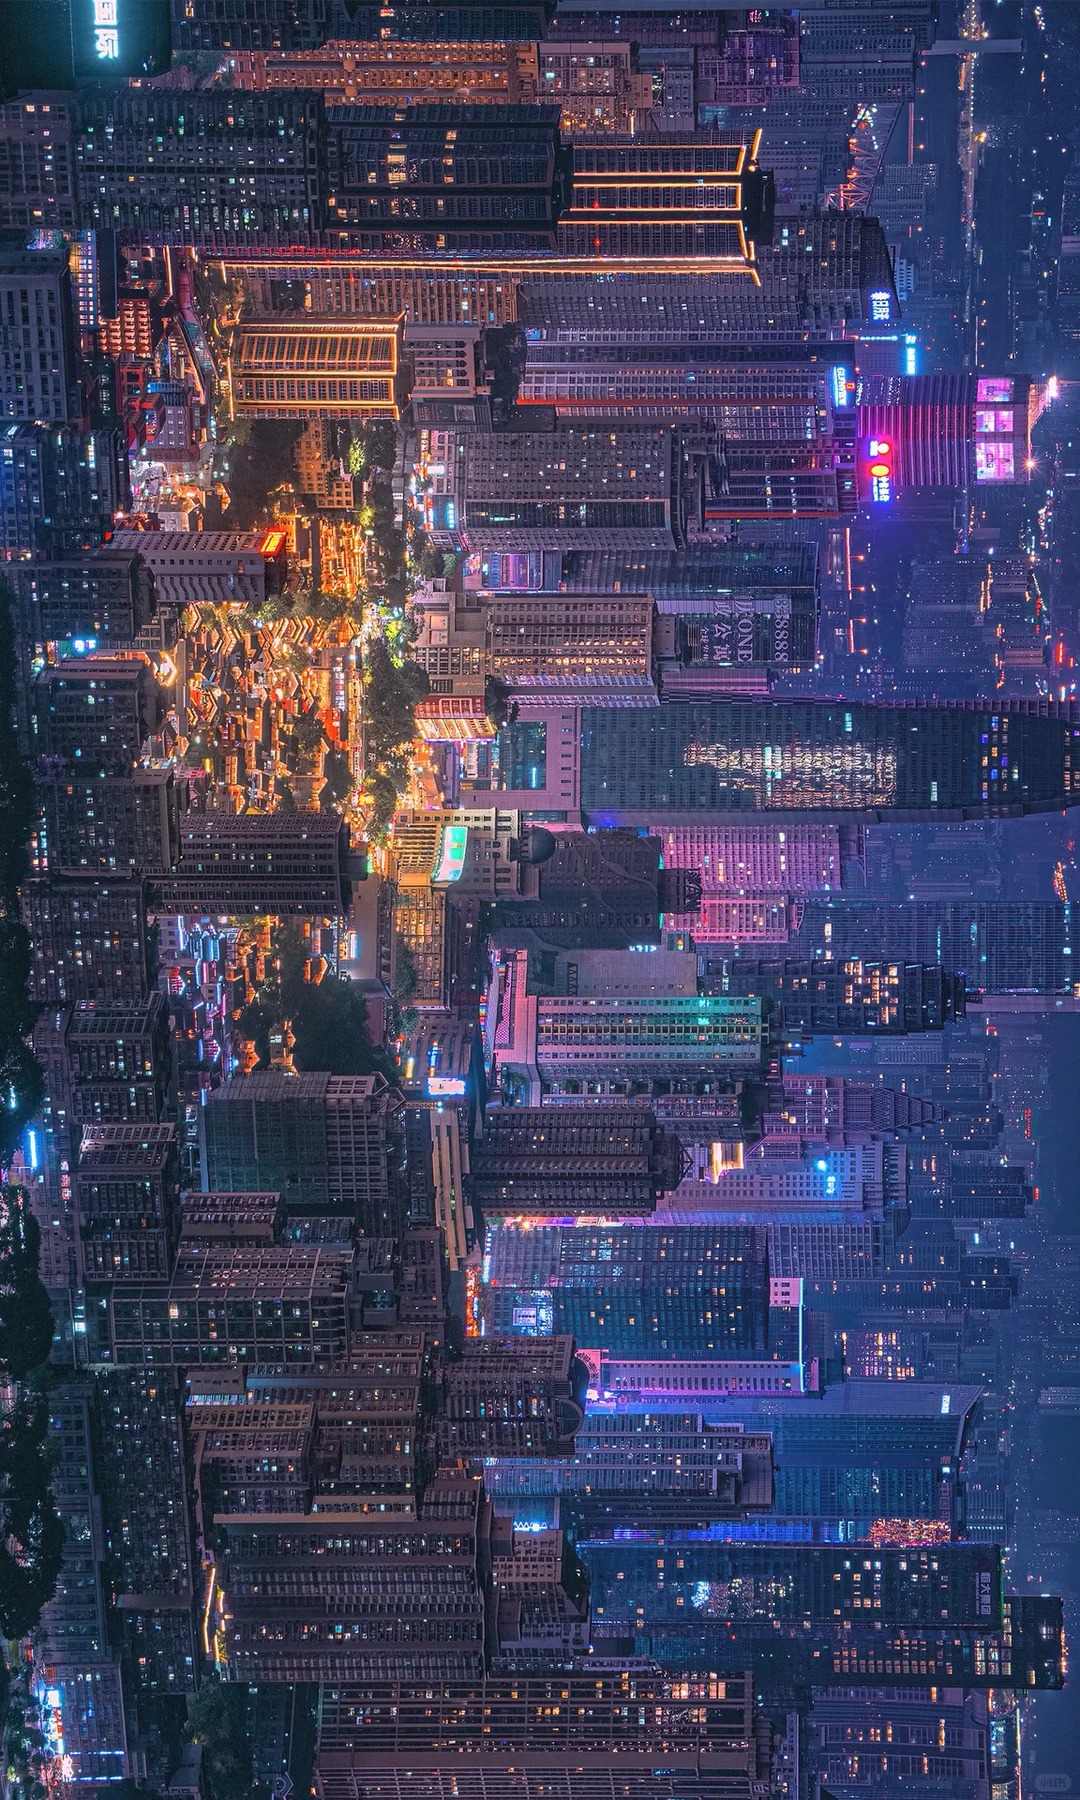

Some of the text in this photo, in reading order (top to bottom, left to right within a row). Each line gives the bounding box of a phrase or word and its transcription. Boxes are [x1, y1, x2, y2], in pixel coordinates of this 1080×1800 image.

[94, 0, 118, 59] 国际
[980, 1572, 991, 1615] 恒大集团
